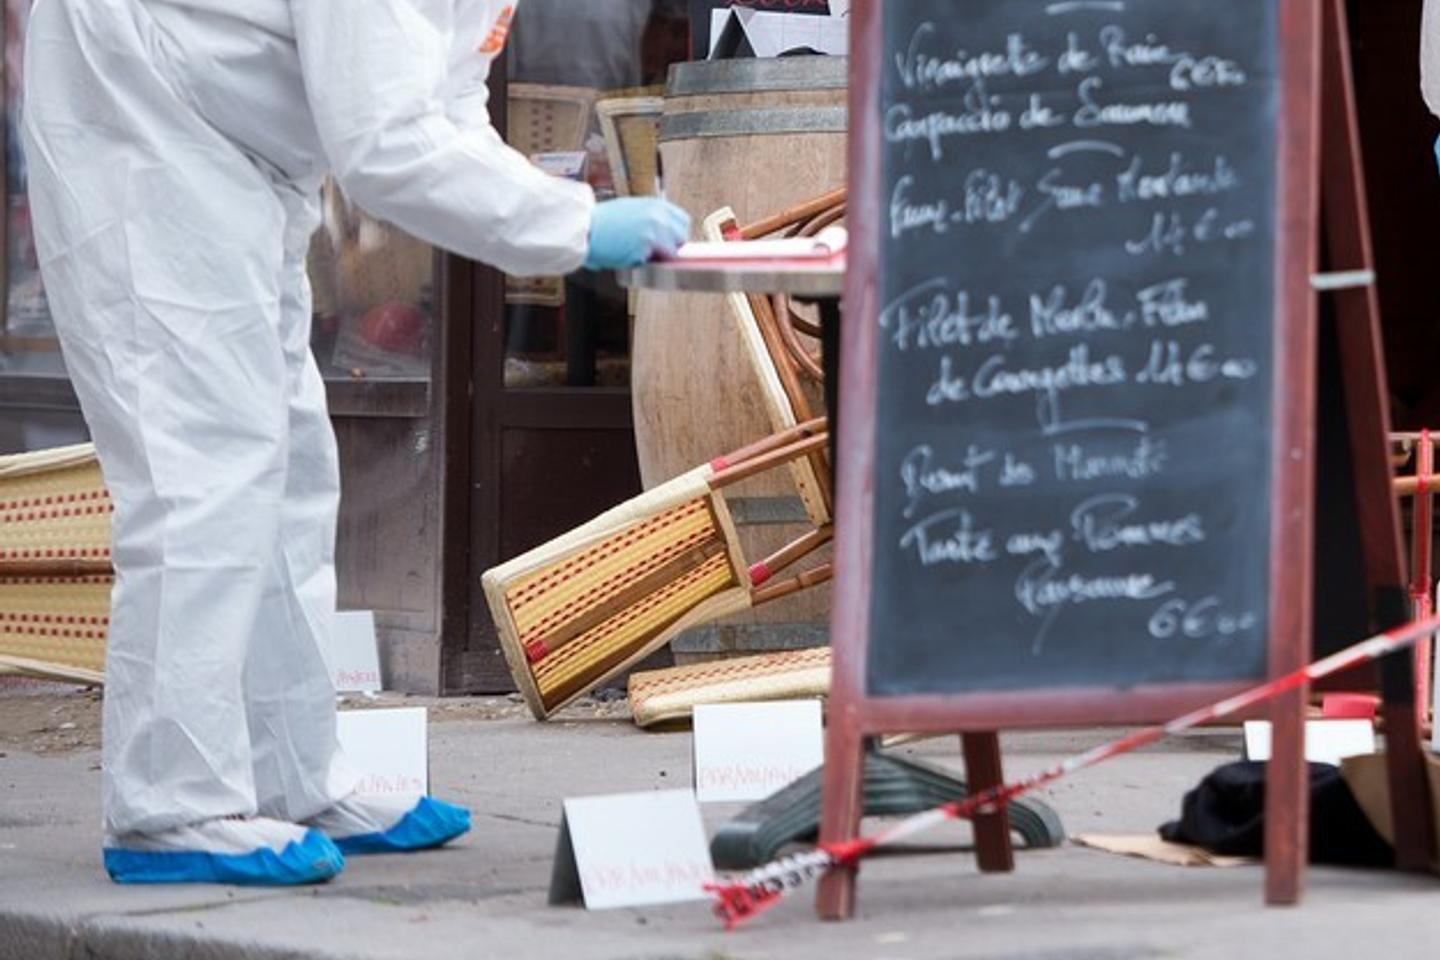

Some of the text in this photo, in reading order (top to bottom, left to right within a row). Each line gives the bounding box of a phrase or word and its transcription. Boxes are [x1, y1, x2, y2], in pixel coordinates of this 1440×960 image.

[1019, 92, 1065, 129] de
[976, 294, 1019, 343] de
[926, 355, 969, 406] de
